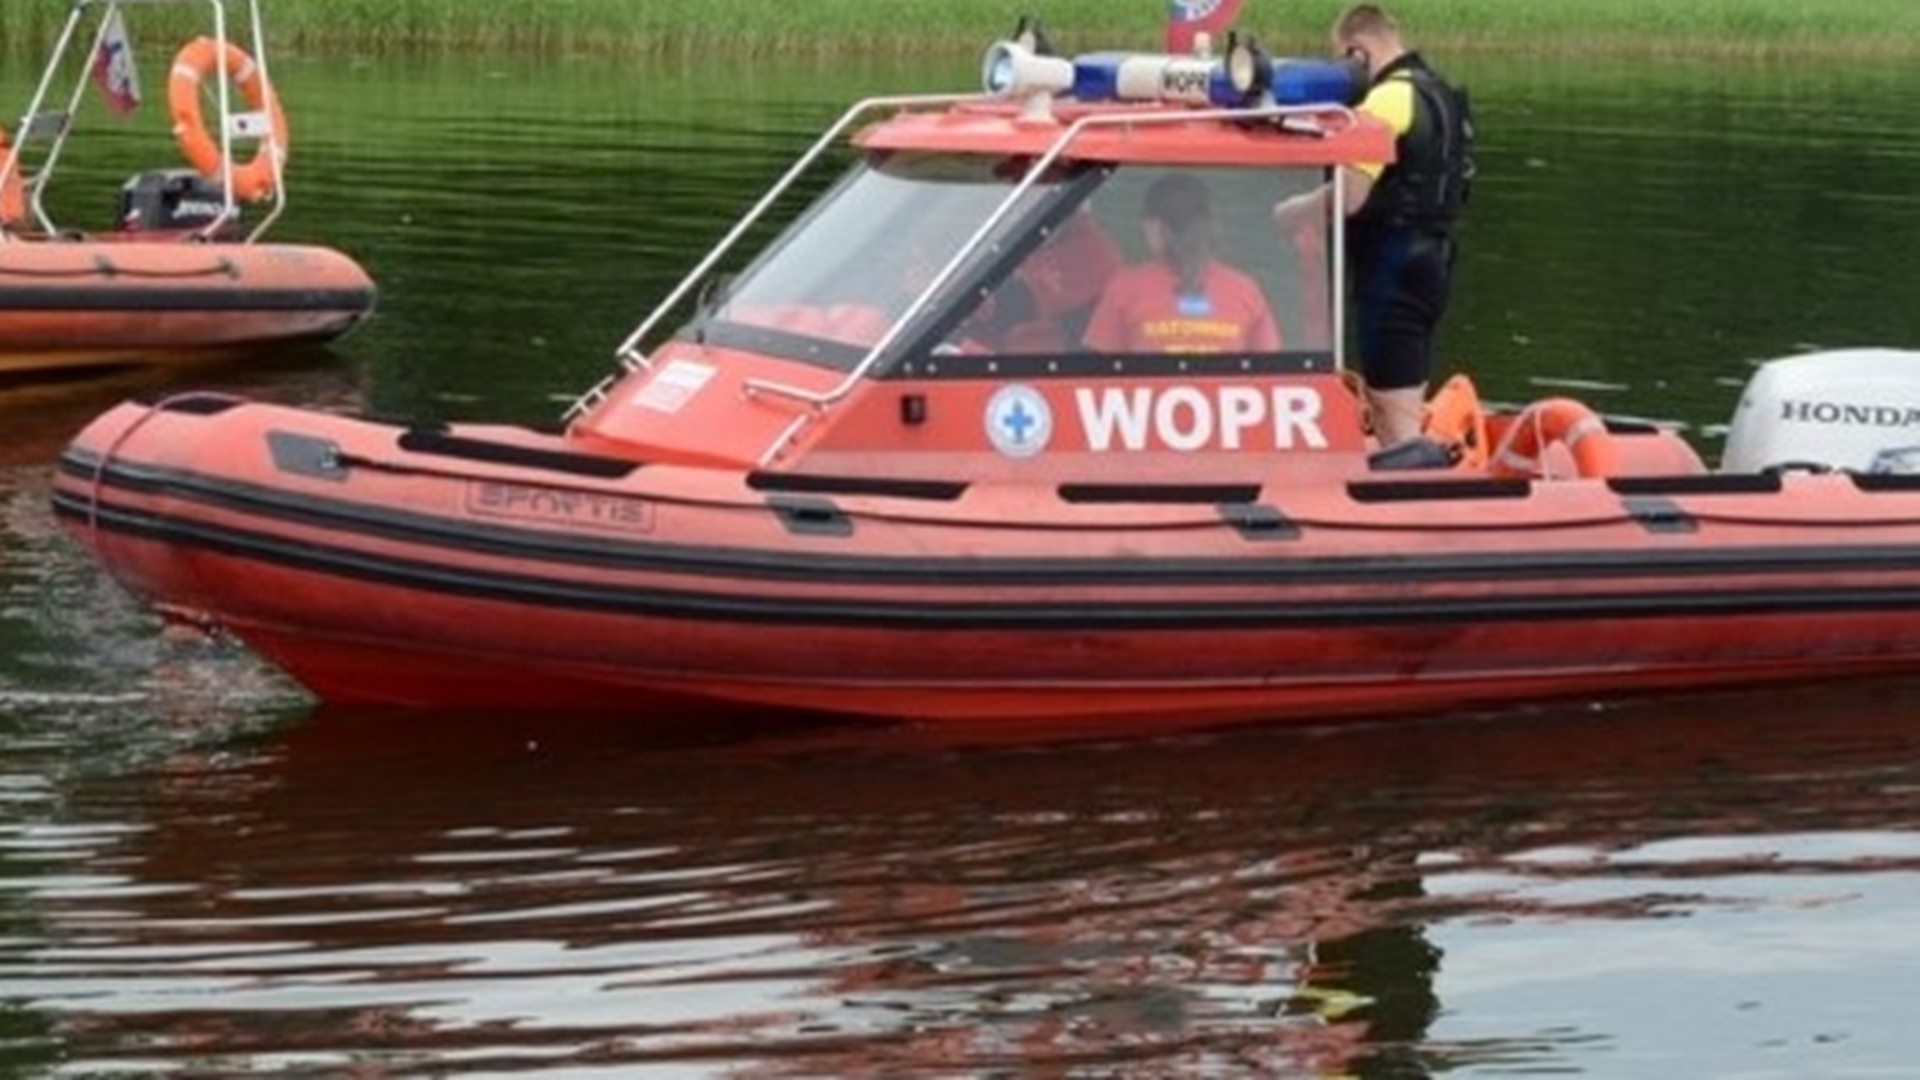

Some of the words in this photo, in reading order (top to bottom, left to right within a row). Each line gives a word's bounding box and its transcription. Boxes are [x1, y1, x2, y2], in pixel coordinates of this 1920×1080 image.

[1162, 69, 1208, 94] WOPR
[1075, 385, 1328, 451] WOPR
[1781, 401, 1920, 427] HONDA
